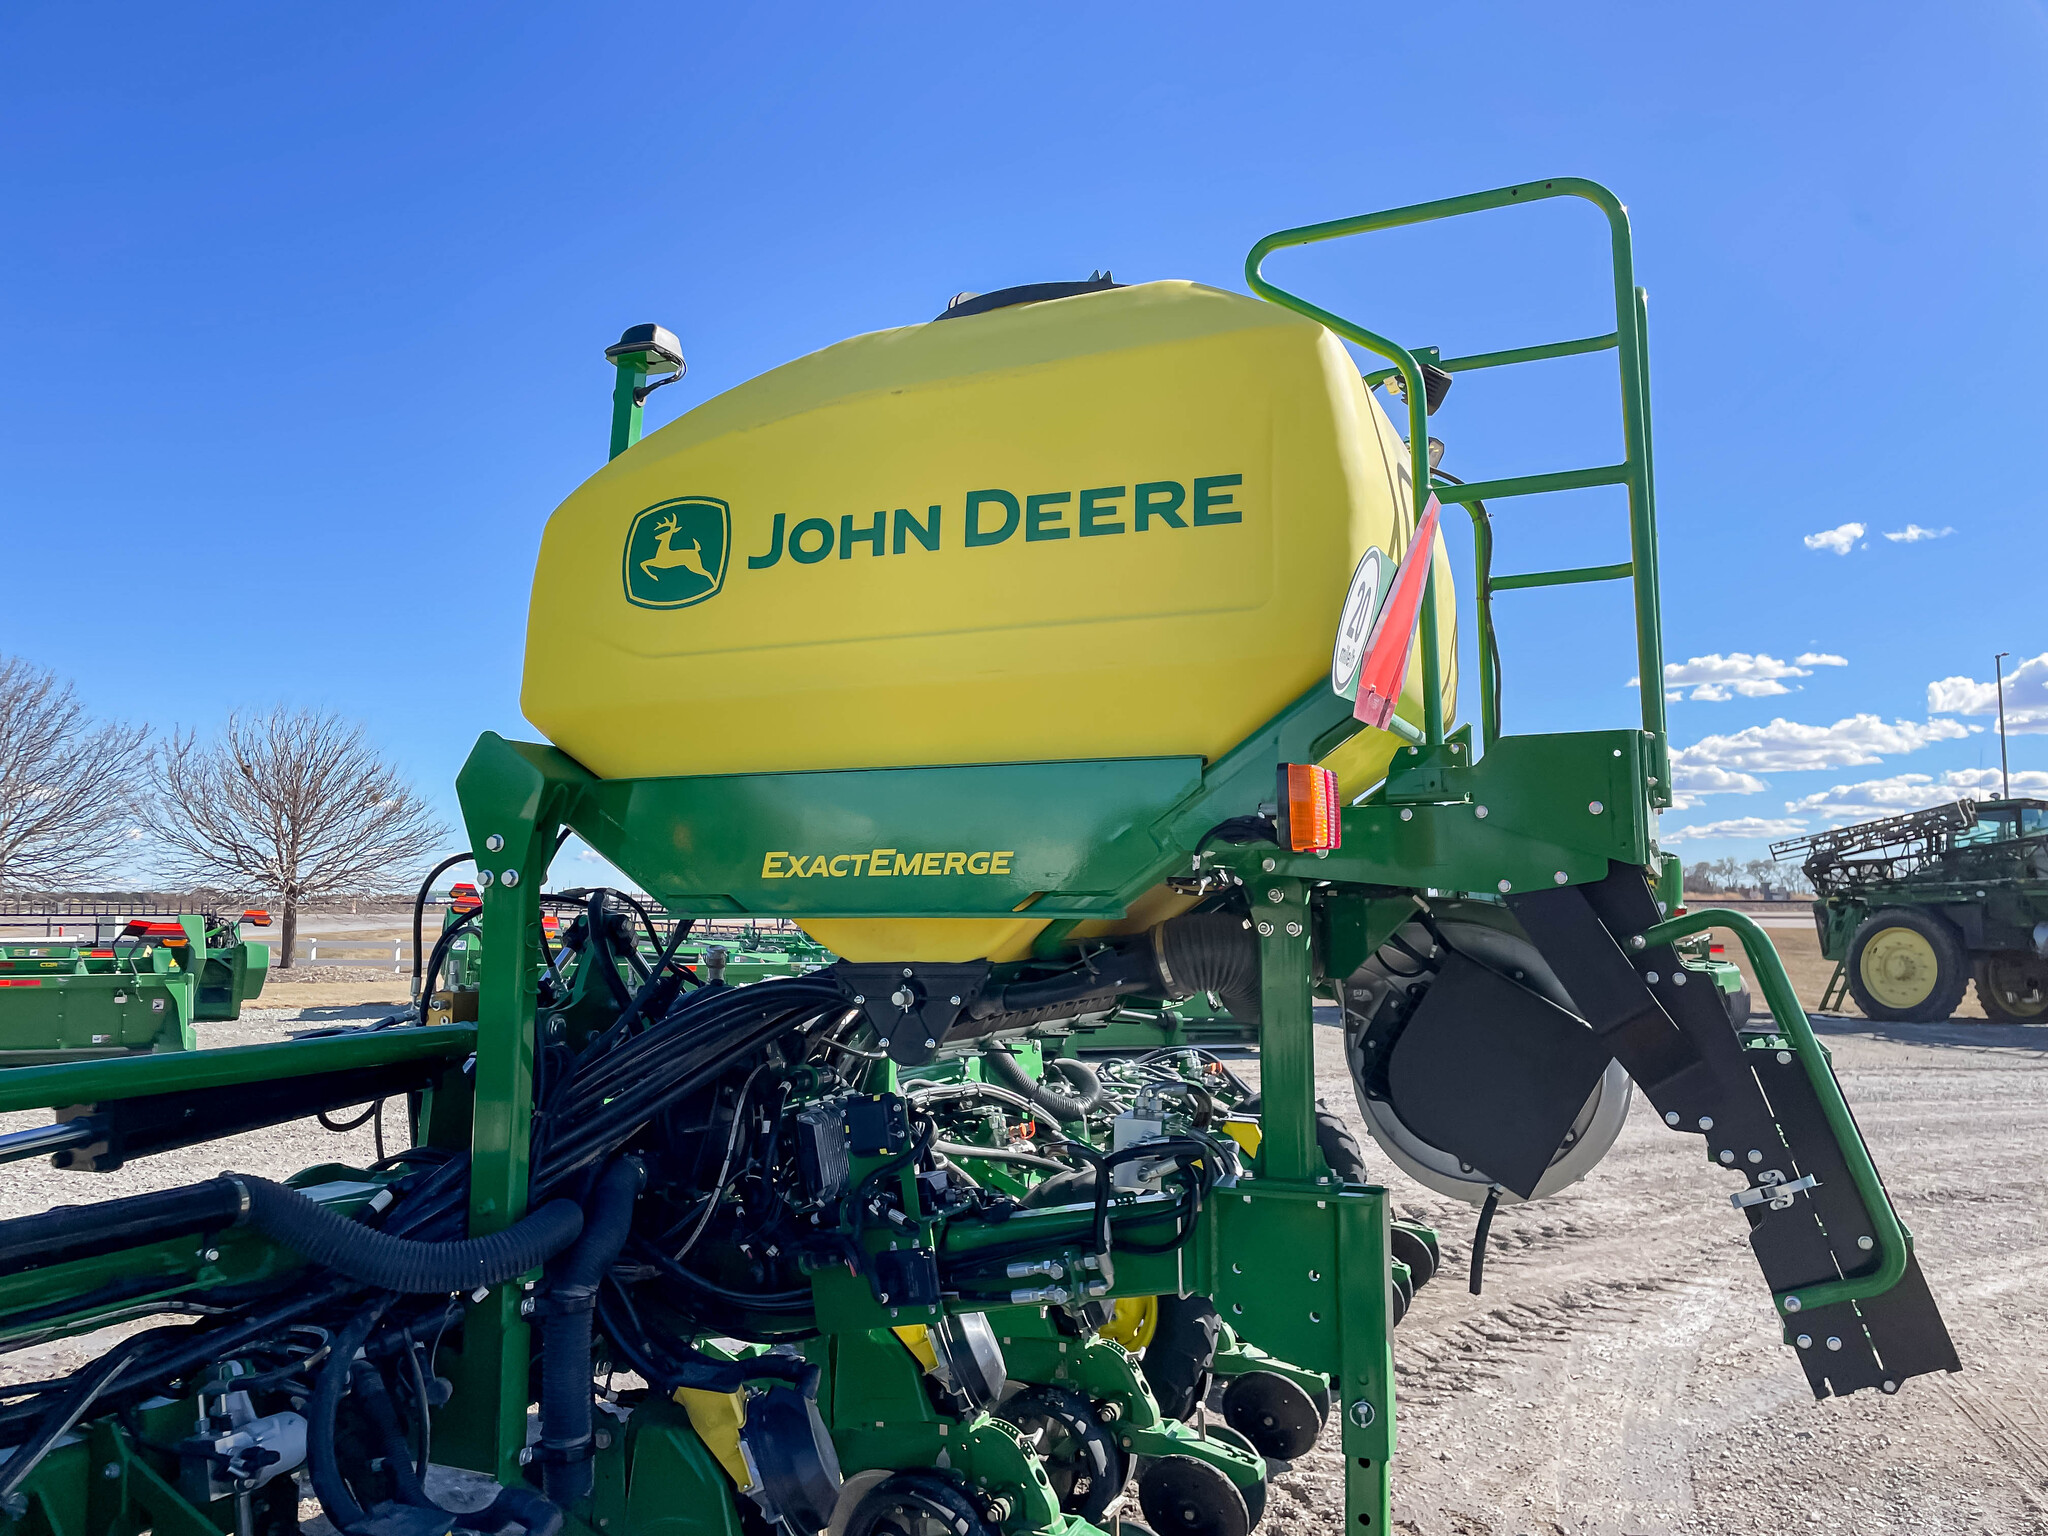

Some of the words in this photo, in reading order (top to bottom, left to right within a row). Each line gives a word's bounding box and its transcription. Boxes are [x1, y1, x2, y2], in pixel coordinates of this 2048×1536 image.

[748, 505, 942, 570] JOHN
[965, 474, 1243, 548] DEERE
[1346, 581, 1372, 643] 20
